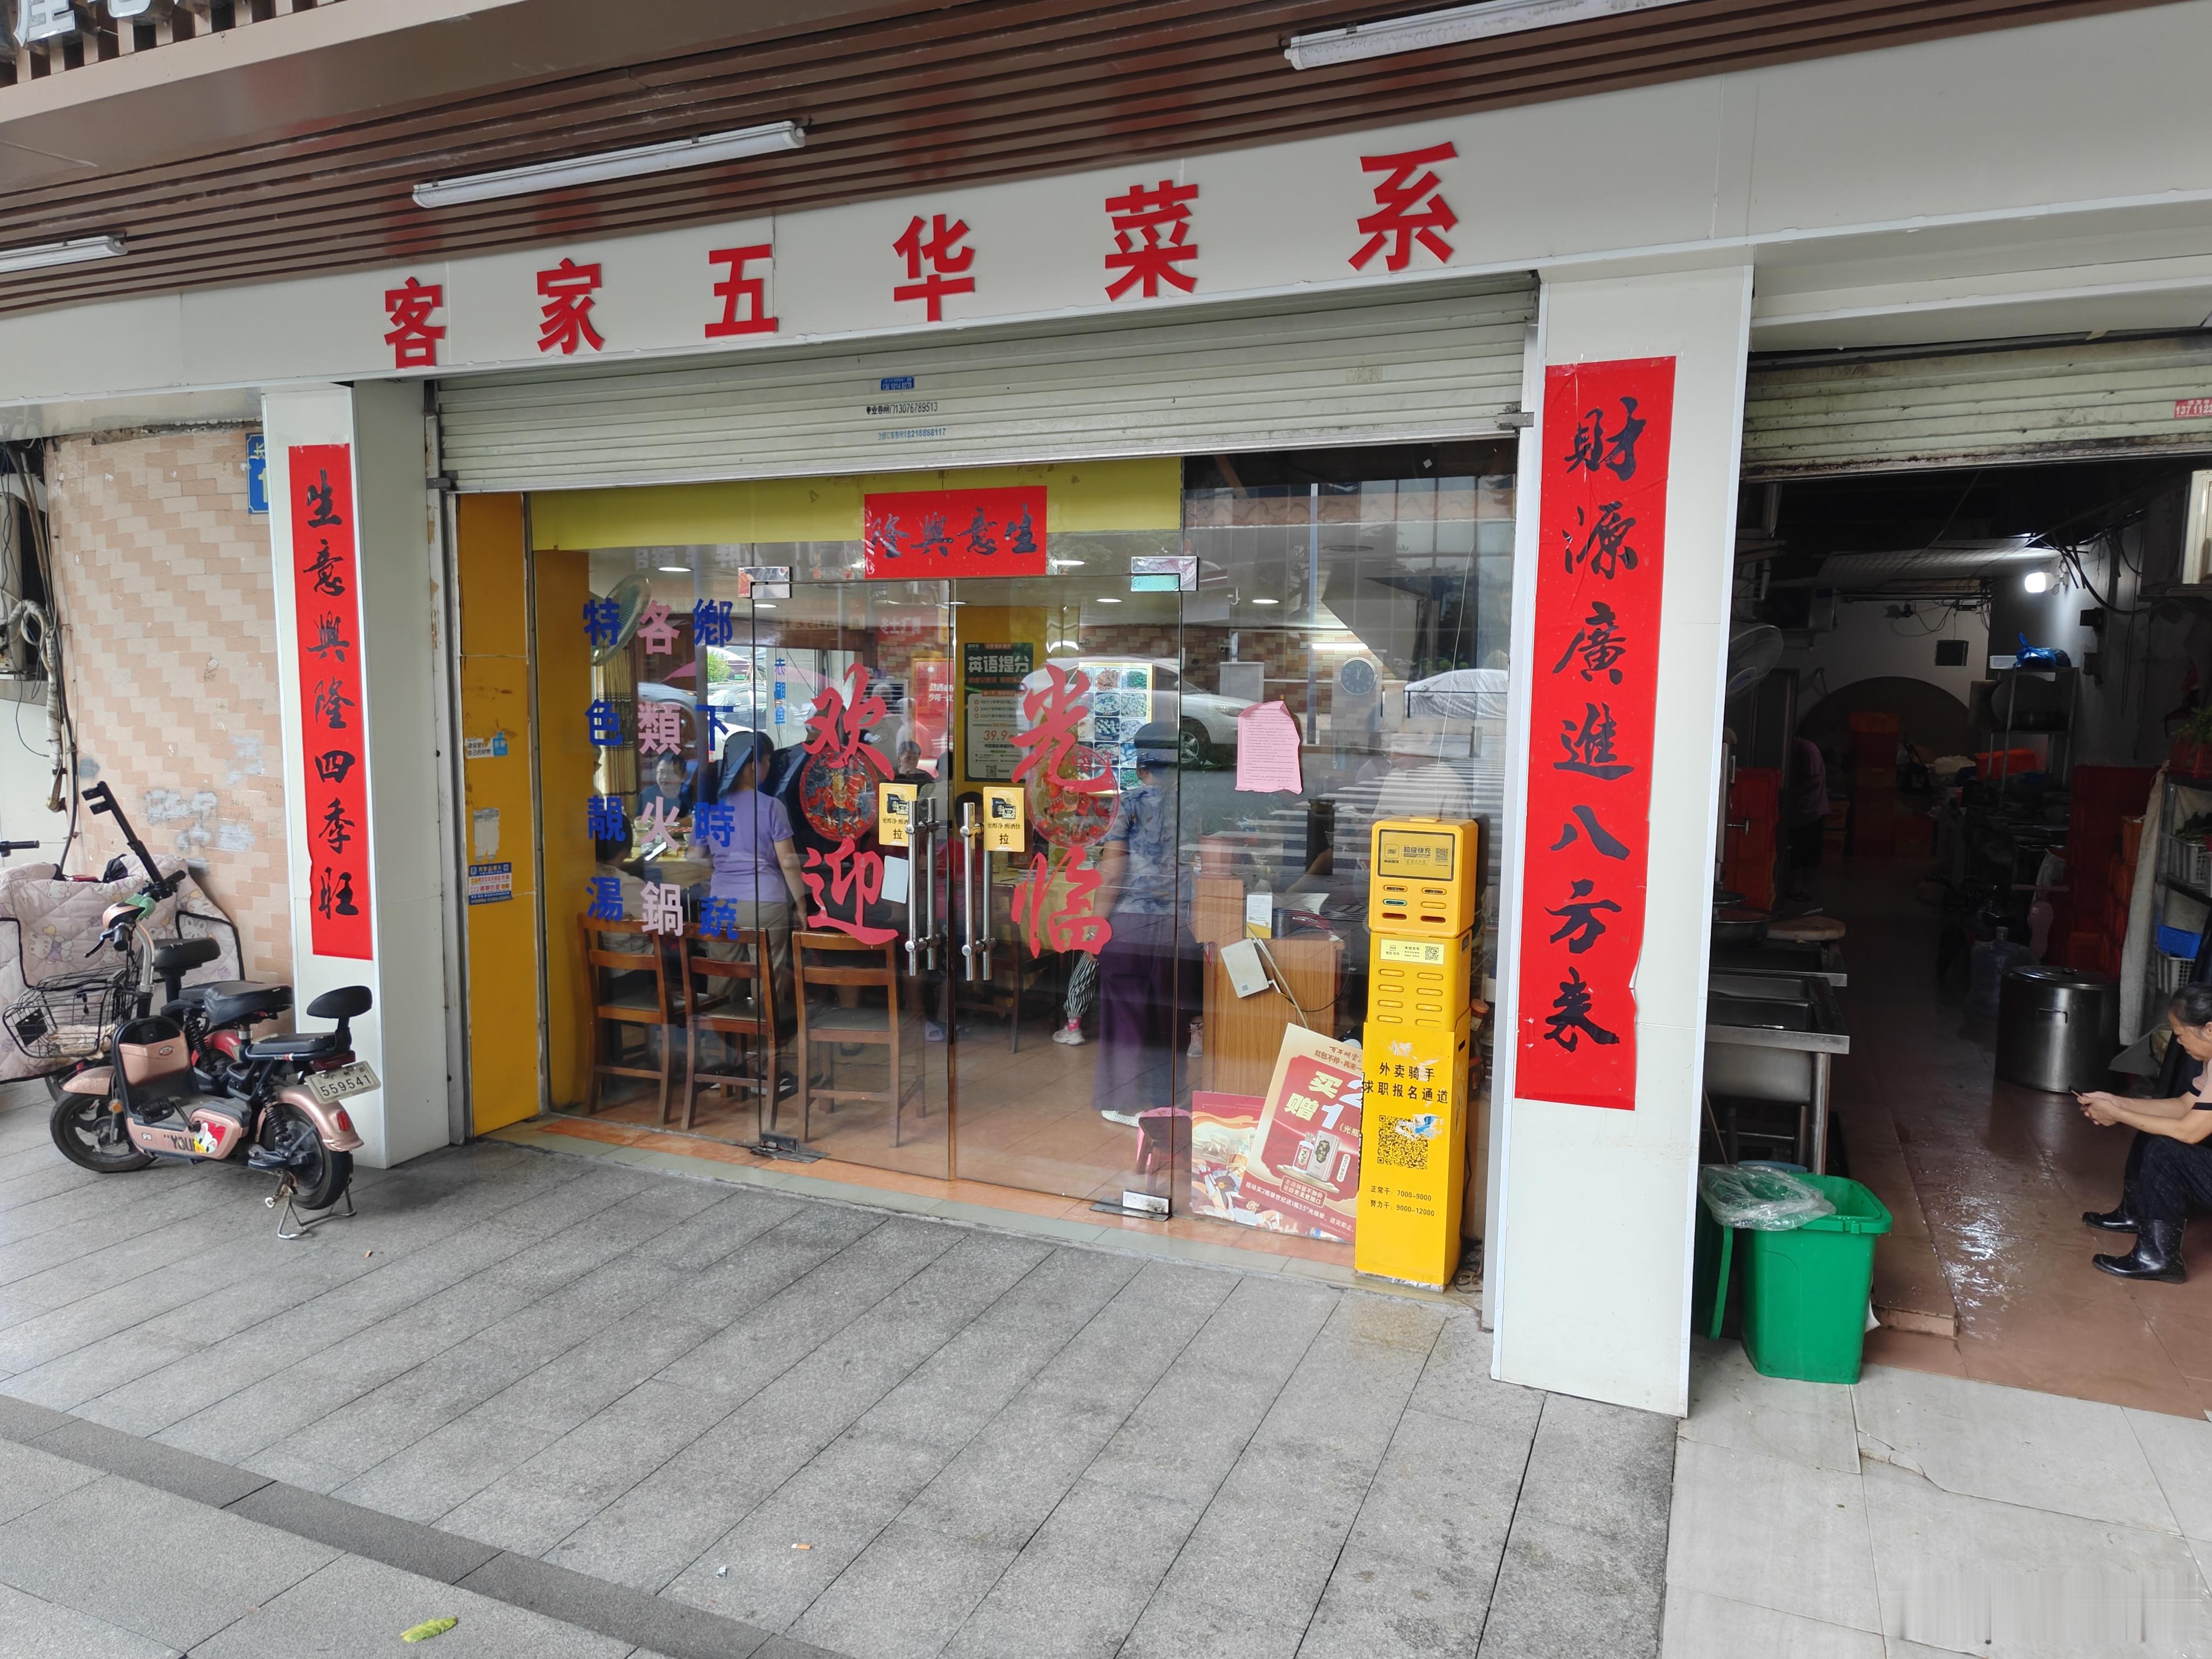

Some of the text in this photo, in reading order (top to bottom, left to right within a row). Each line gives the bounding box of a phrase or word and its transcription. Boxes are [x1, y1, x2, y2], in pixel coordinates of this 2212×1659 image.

[385, 141, 1458, 369] 客家五华菜系
[2176, 406, 2191, 415] 137
[968, 656, 1029, 673] 英语提分
[893, 828, 902, 840] 拉
[999, 833, 1009, 845] 拉
[1379, 1062, 1435, 1082] 外卖骑手
[320, 1074, 372, 1096] 559541
[1362, 1079, 1448, 1103] 求职报名通道
